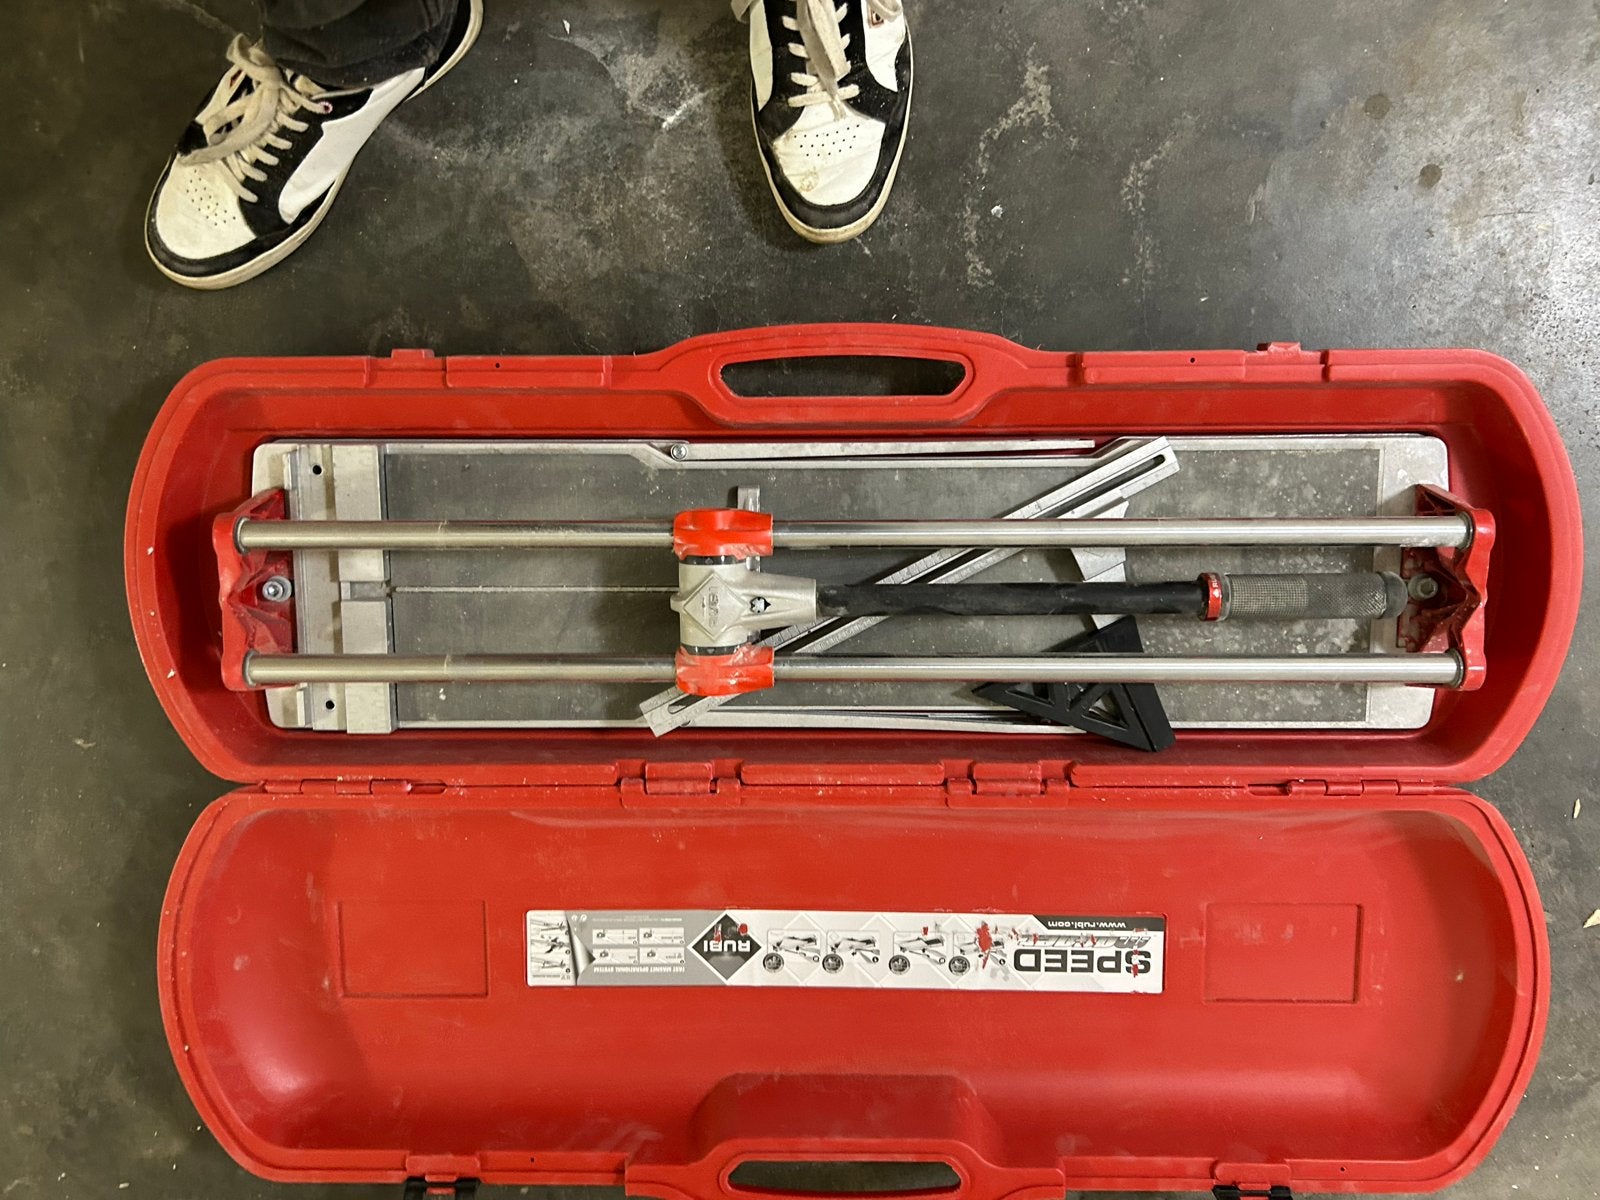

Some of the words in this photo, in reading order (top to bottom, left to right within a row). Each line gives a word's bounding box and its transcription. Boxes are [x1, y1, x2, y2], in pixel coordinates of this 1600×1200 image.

[1047, 920, 1127, 929] www.rubi.com
[703, 940, 751, 953] RUBI
[1014, 948, 1151, 974] SPEED
